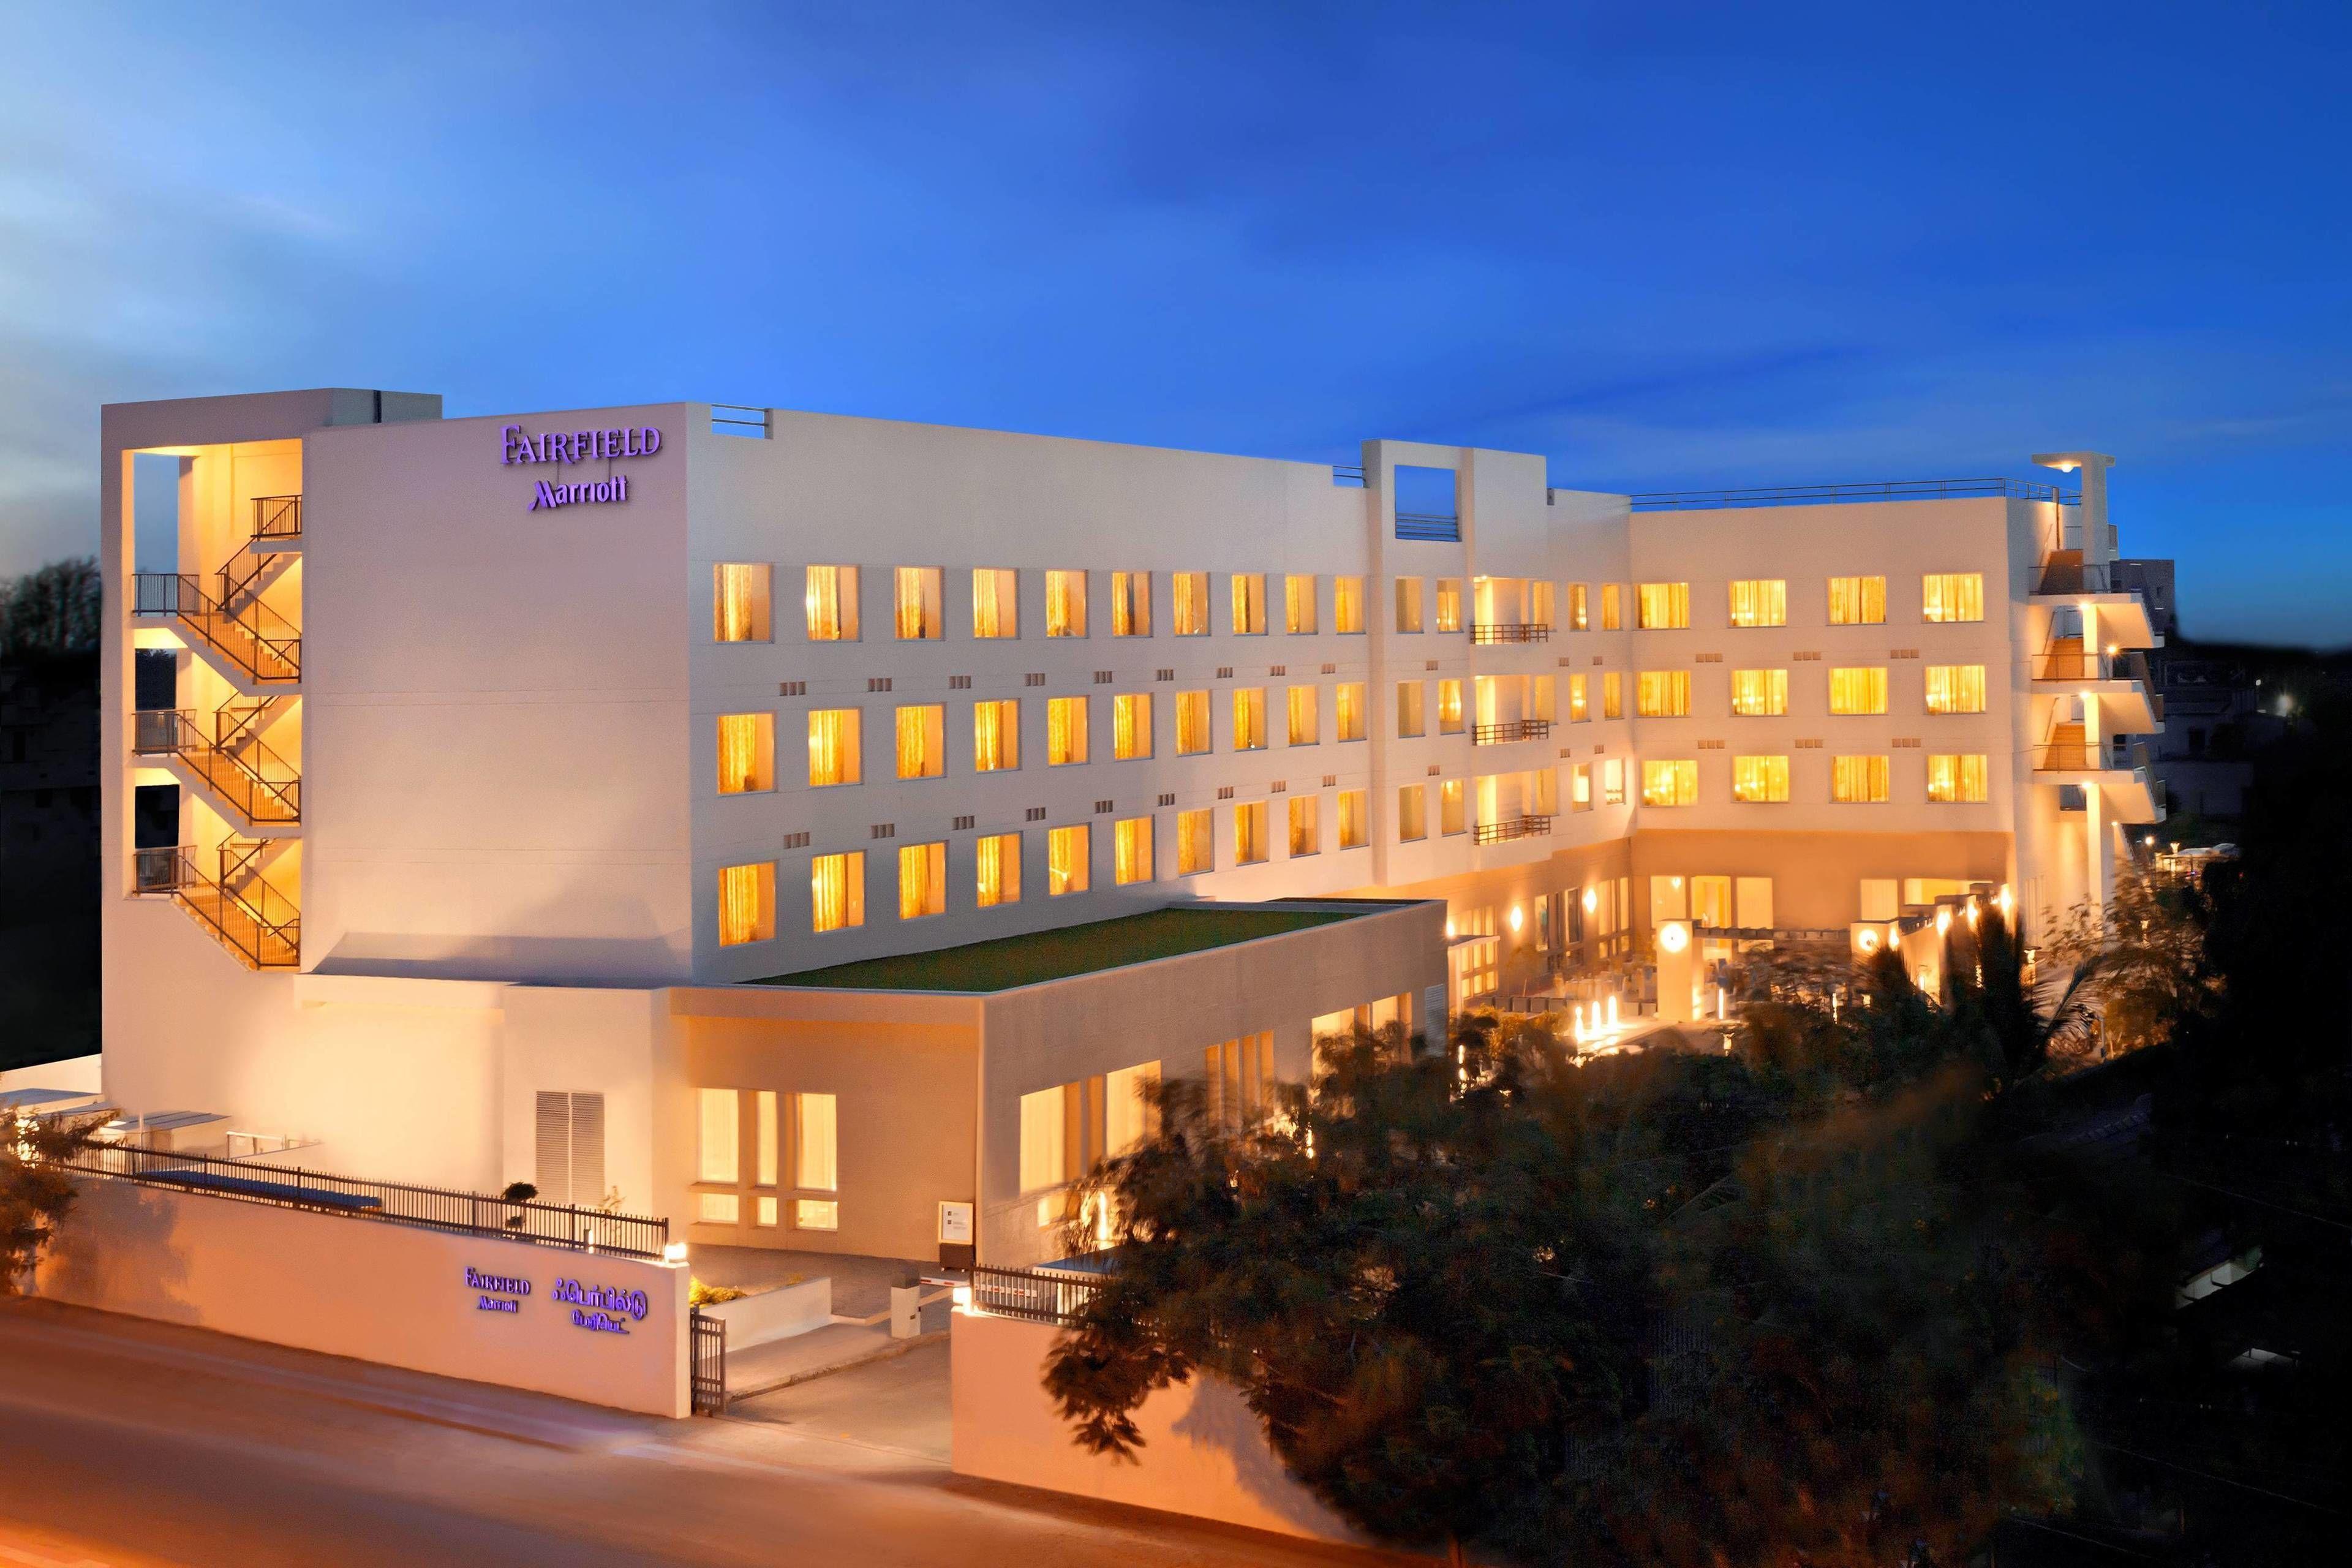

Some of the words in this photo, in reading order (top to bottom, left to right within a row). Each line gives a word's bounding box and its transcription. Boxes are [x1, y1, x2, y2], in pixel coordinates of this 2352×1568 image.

[500, 424, 662, 465] FAIRFIELD
[527, 475, 628, 511] Marriott
[464, 1266, 530, 1295] FAIRFIELD
[477, 1295, 519, 1313] Marriott
